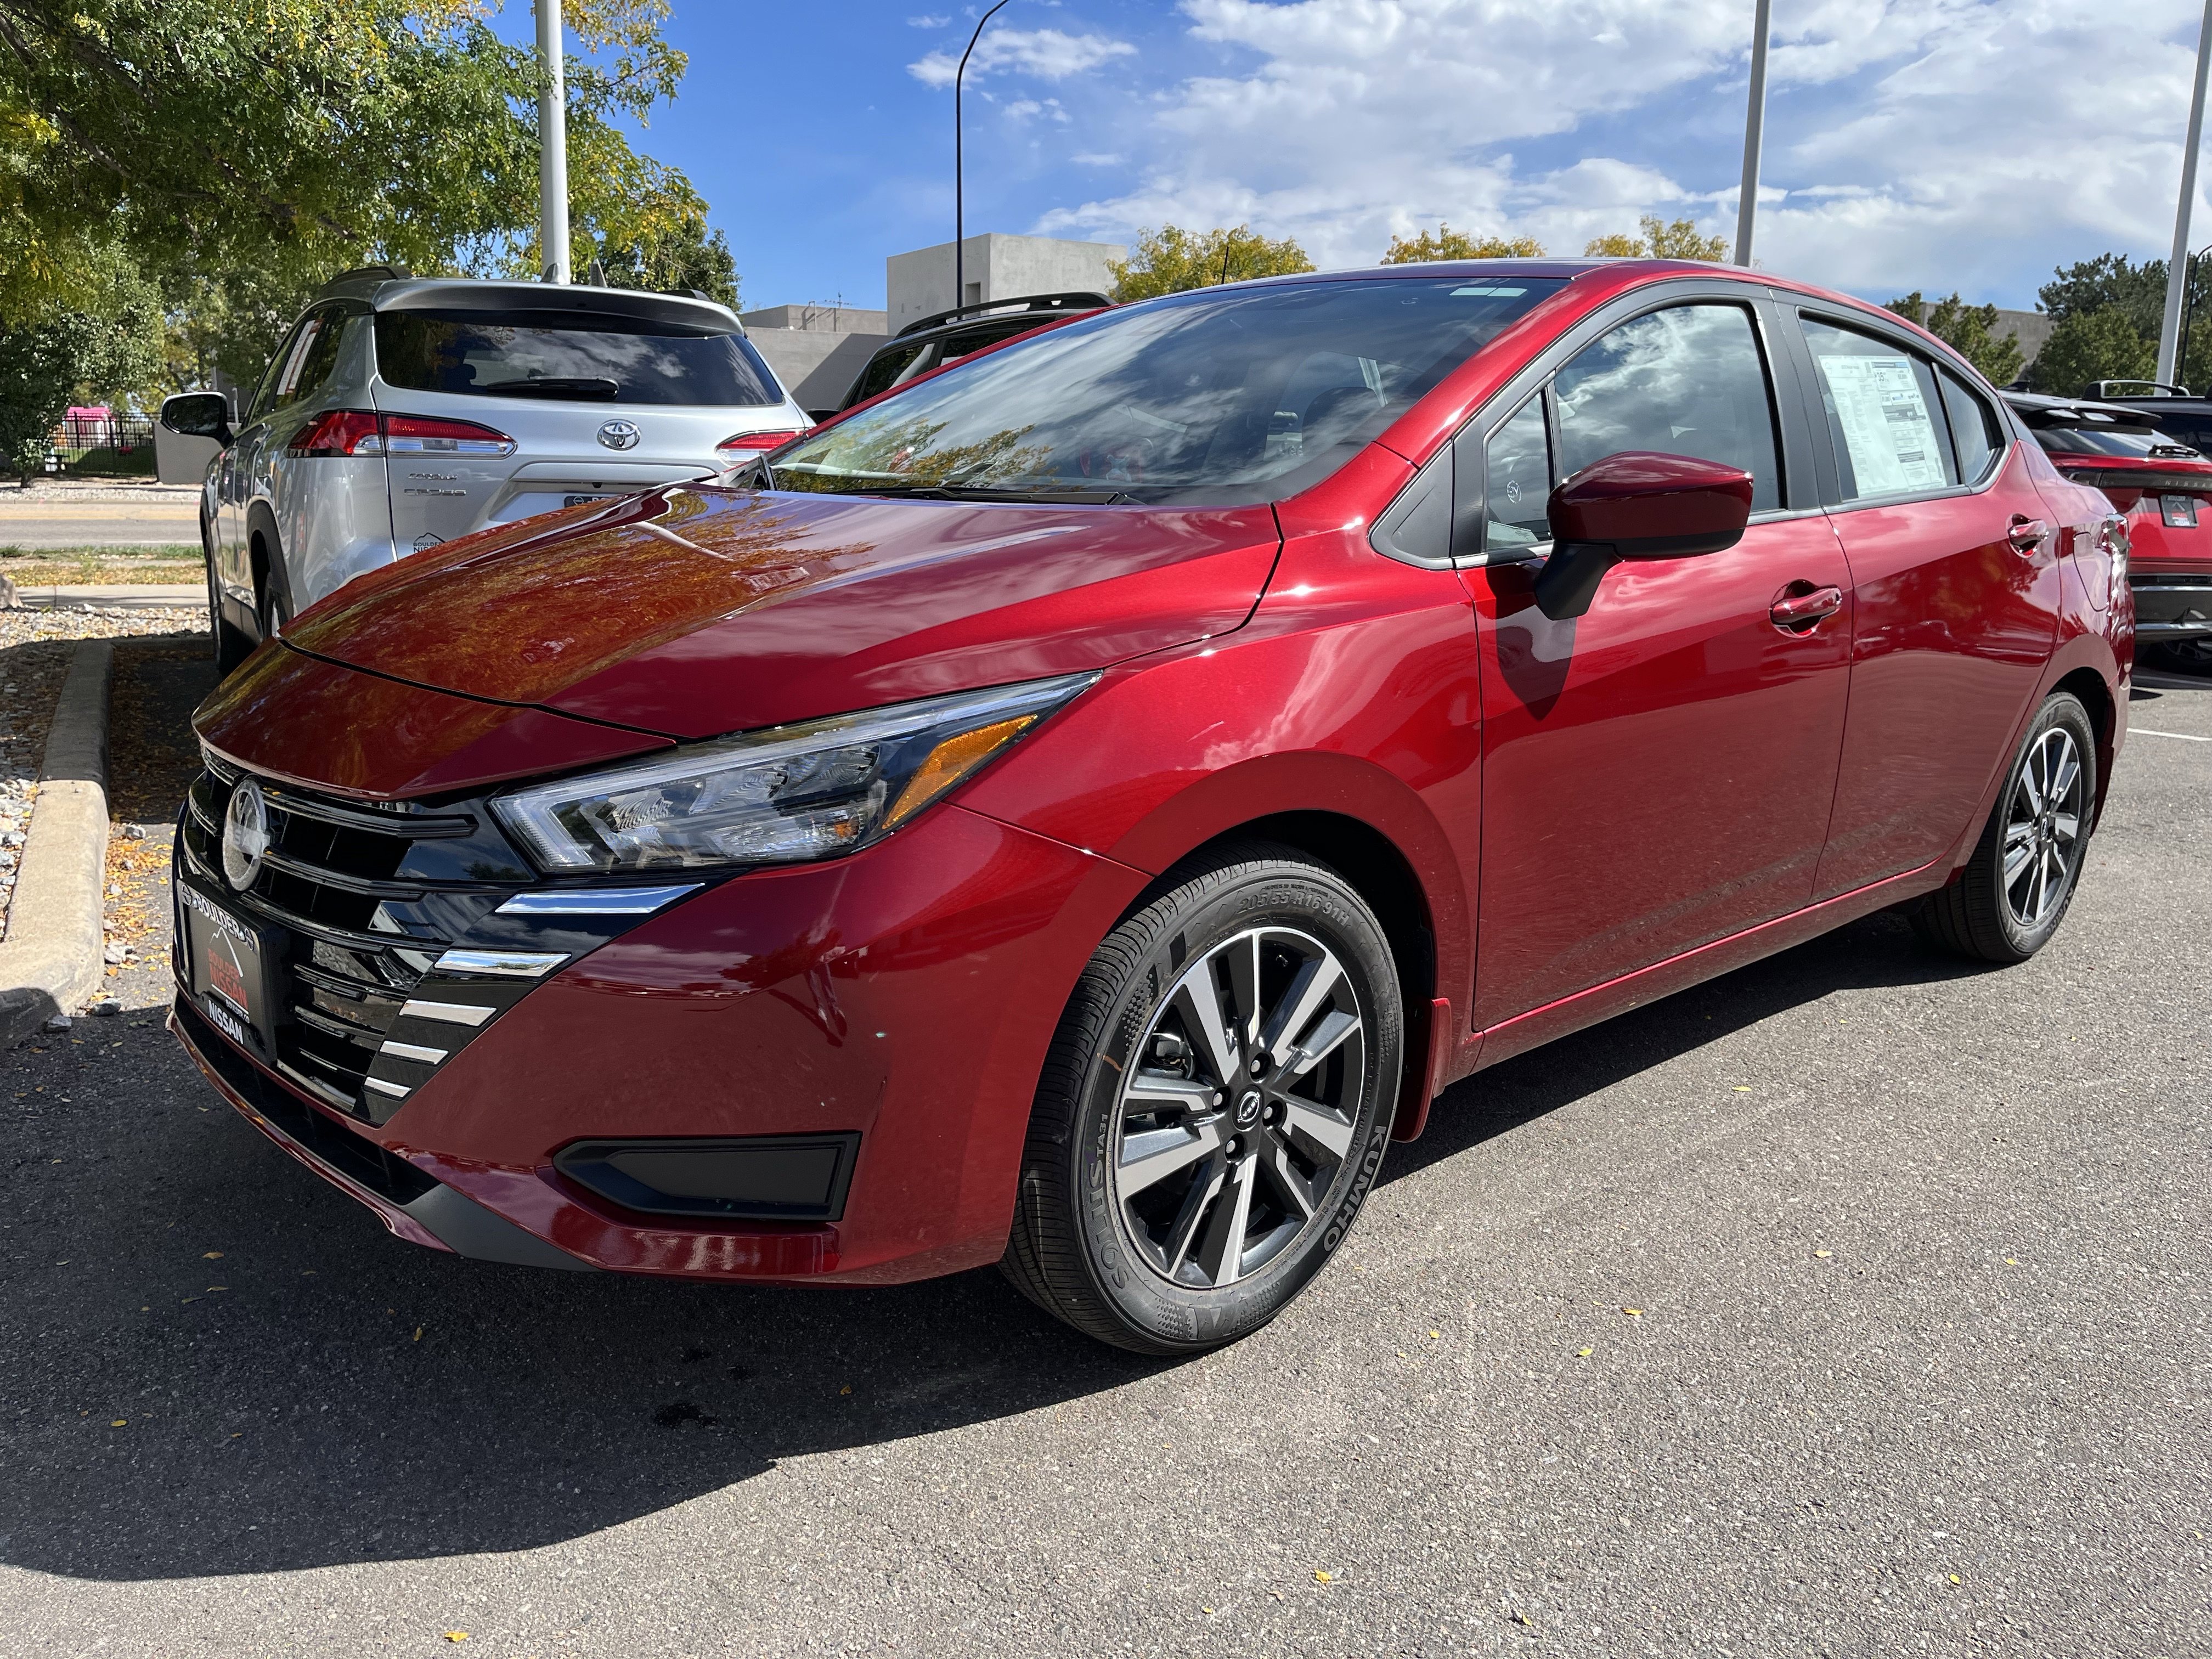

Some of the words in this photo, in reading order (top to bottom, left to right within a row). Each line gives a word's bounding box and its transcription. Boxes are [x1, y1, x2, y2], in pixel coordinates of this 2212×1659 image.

[194, 893, 242, 938] BOULDER
[208, 948, 240, 979] BOULDER
[210, 963, 249, 1011] NISSAN
[208, 1000, 244, 1045] NISSAN
[1096, 1113, 1109, 1158] TA31
[1323, 1125, 1387, 1252] KUMHO
[1090, 1160, 1129, 1289] SOLUS
